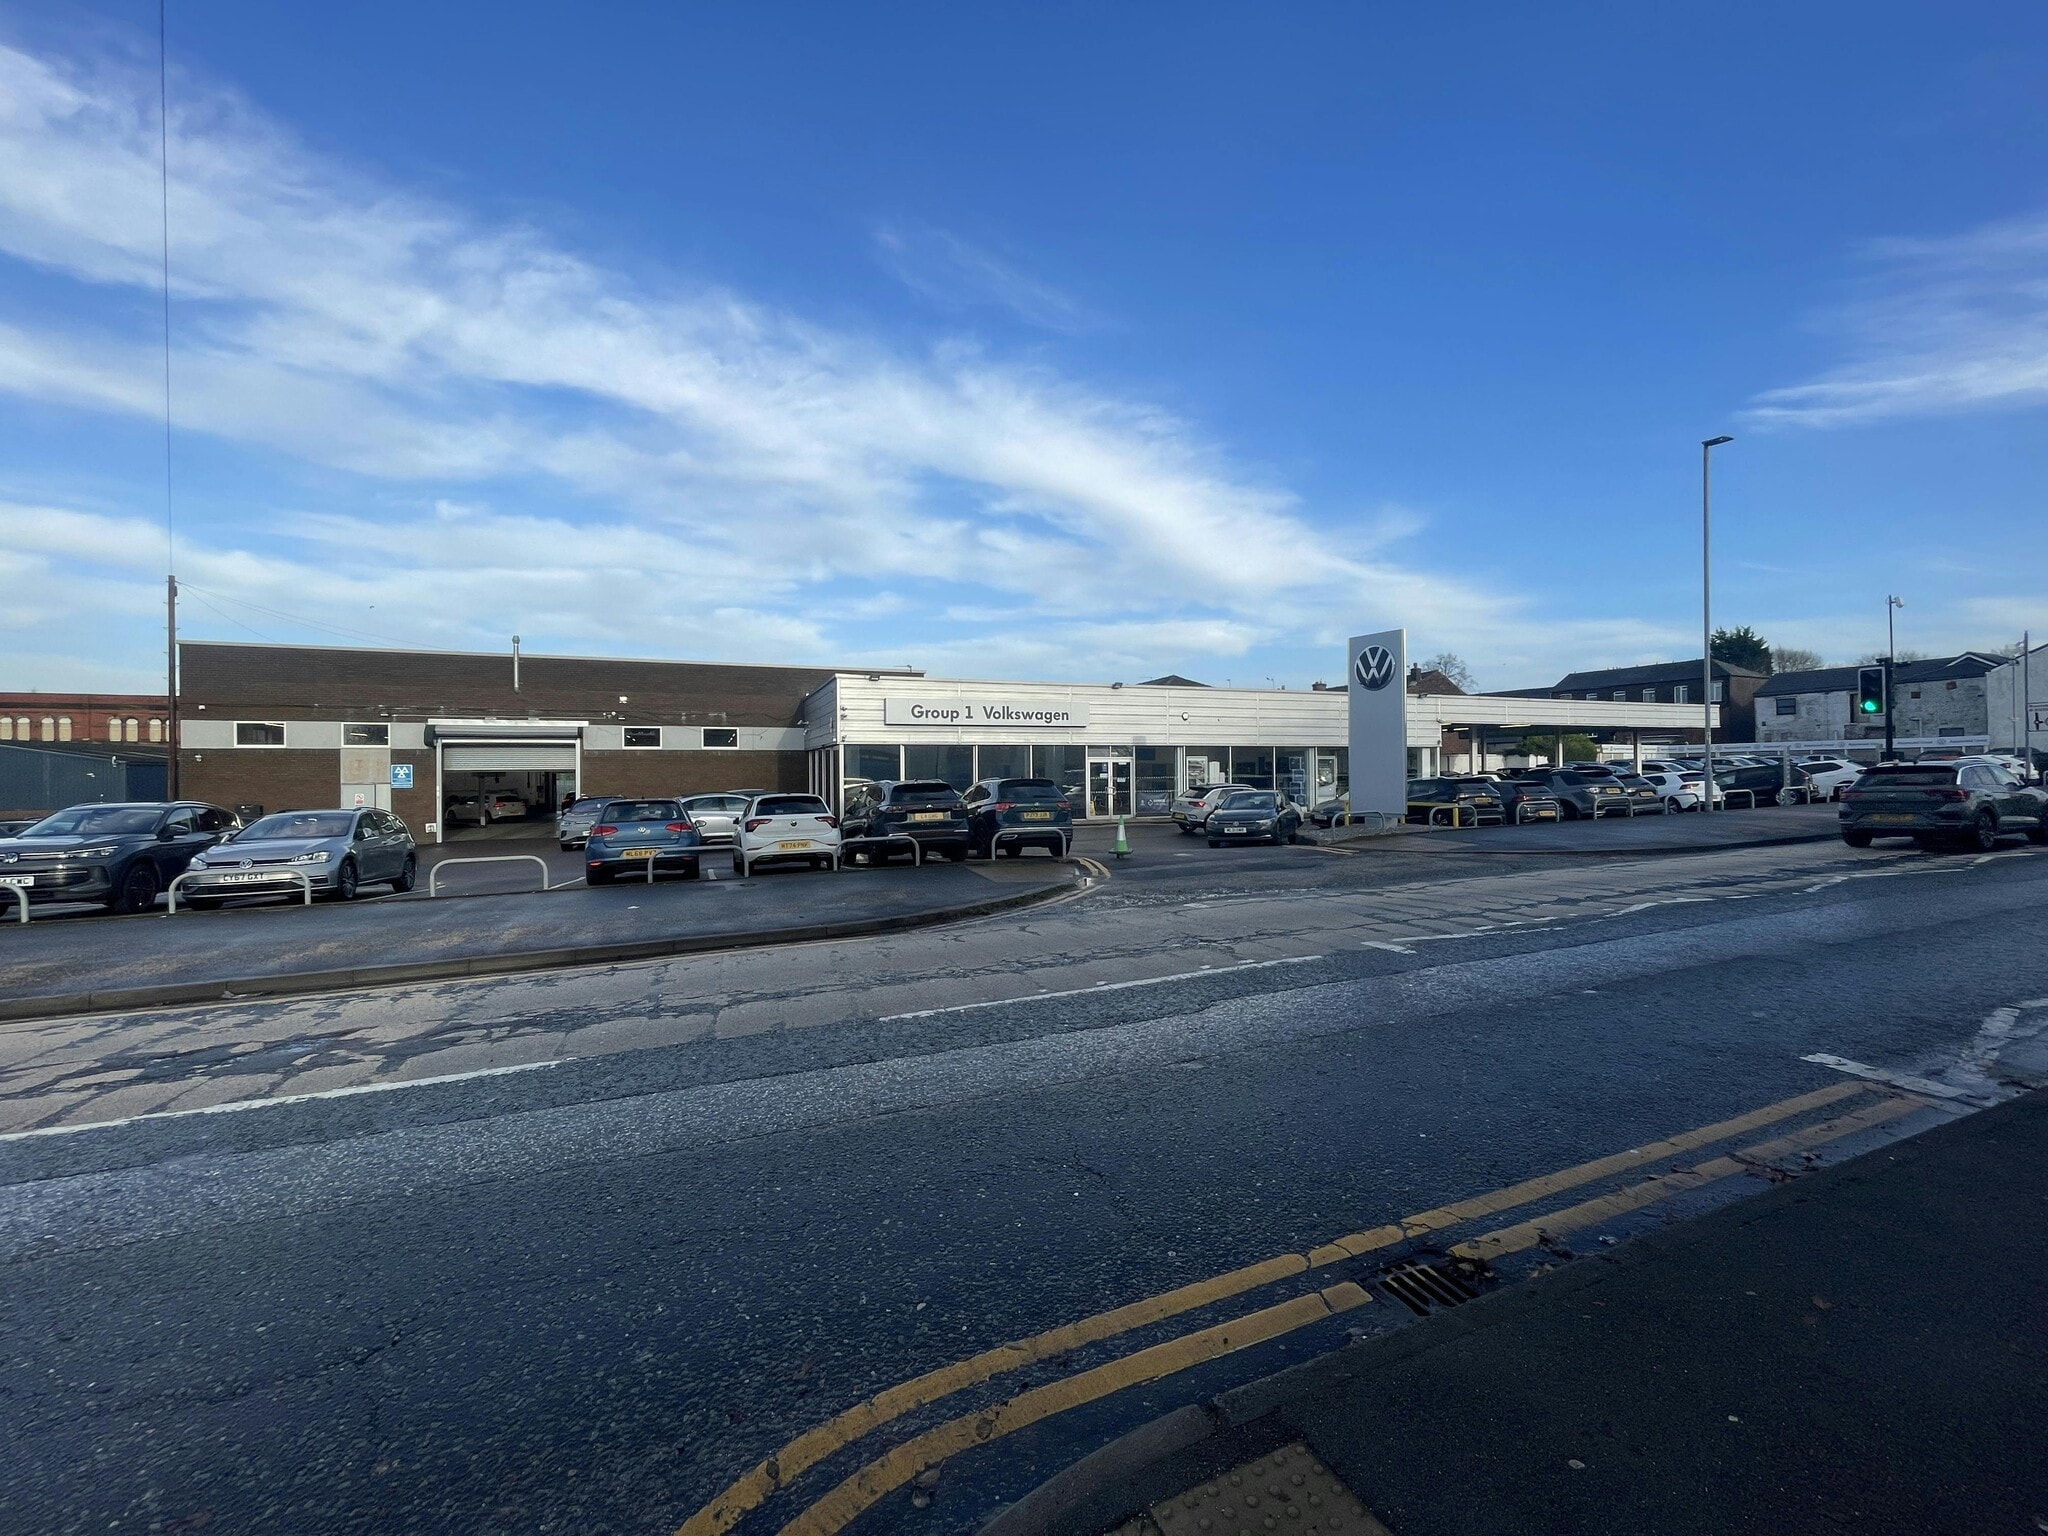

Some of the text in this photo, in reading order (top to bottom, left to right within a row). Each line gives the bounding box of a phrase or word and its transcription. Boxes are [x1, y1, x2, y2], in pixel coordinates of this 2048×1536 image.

[911, 704, 1069, 724] Group 1 Volkswagen
[224, 873, 245, 881] CY67
